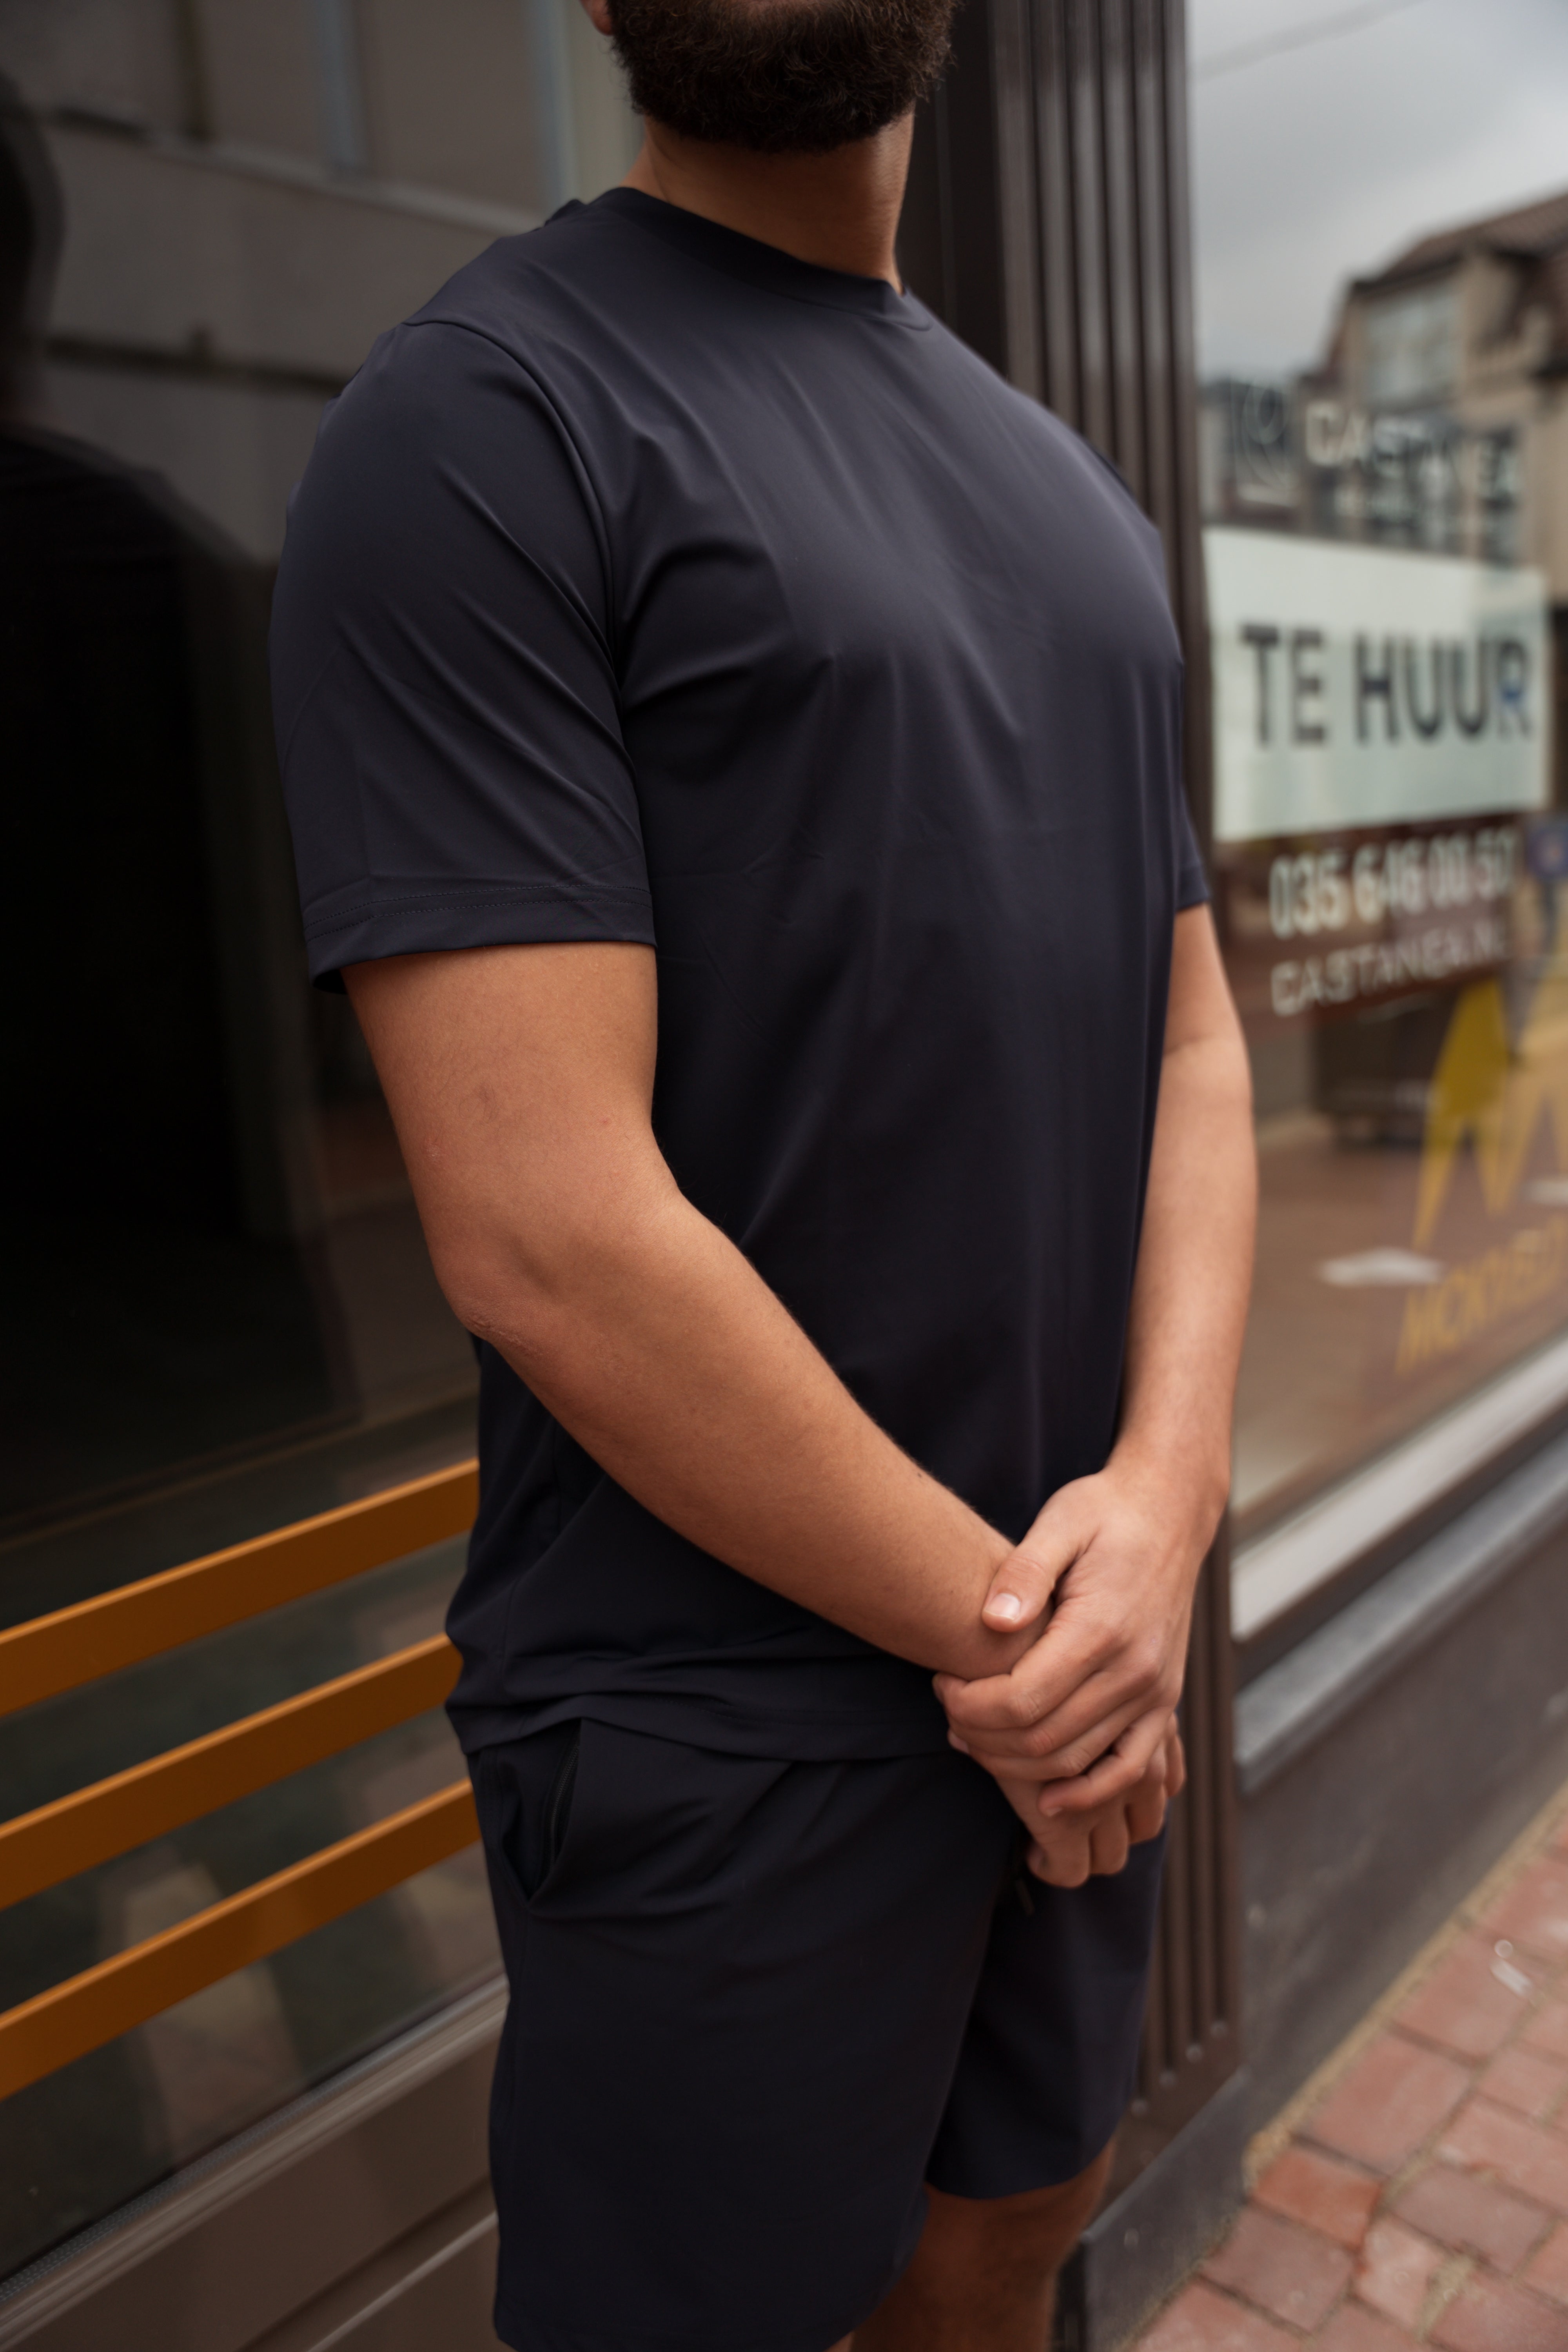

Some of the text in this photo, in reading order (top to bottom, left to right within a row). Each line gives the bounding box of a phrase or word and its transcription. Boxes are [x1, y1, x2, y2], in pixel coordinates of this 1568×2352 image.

[1241, 624, 1532, 748] TE HUUR
[1269, 850, 1350, 939] 035
